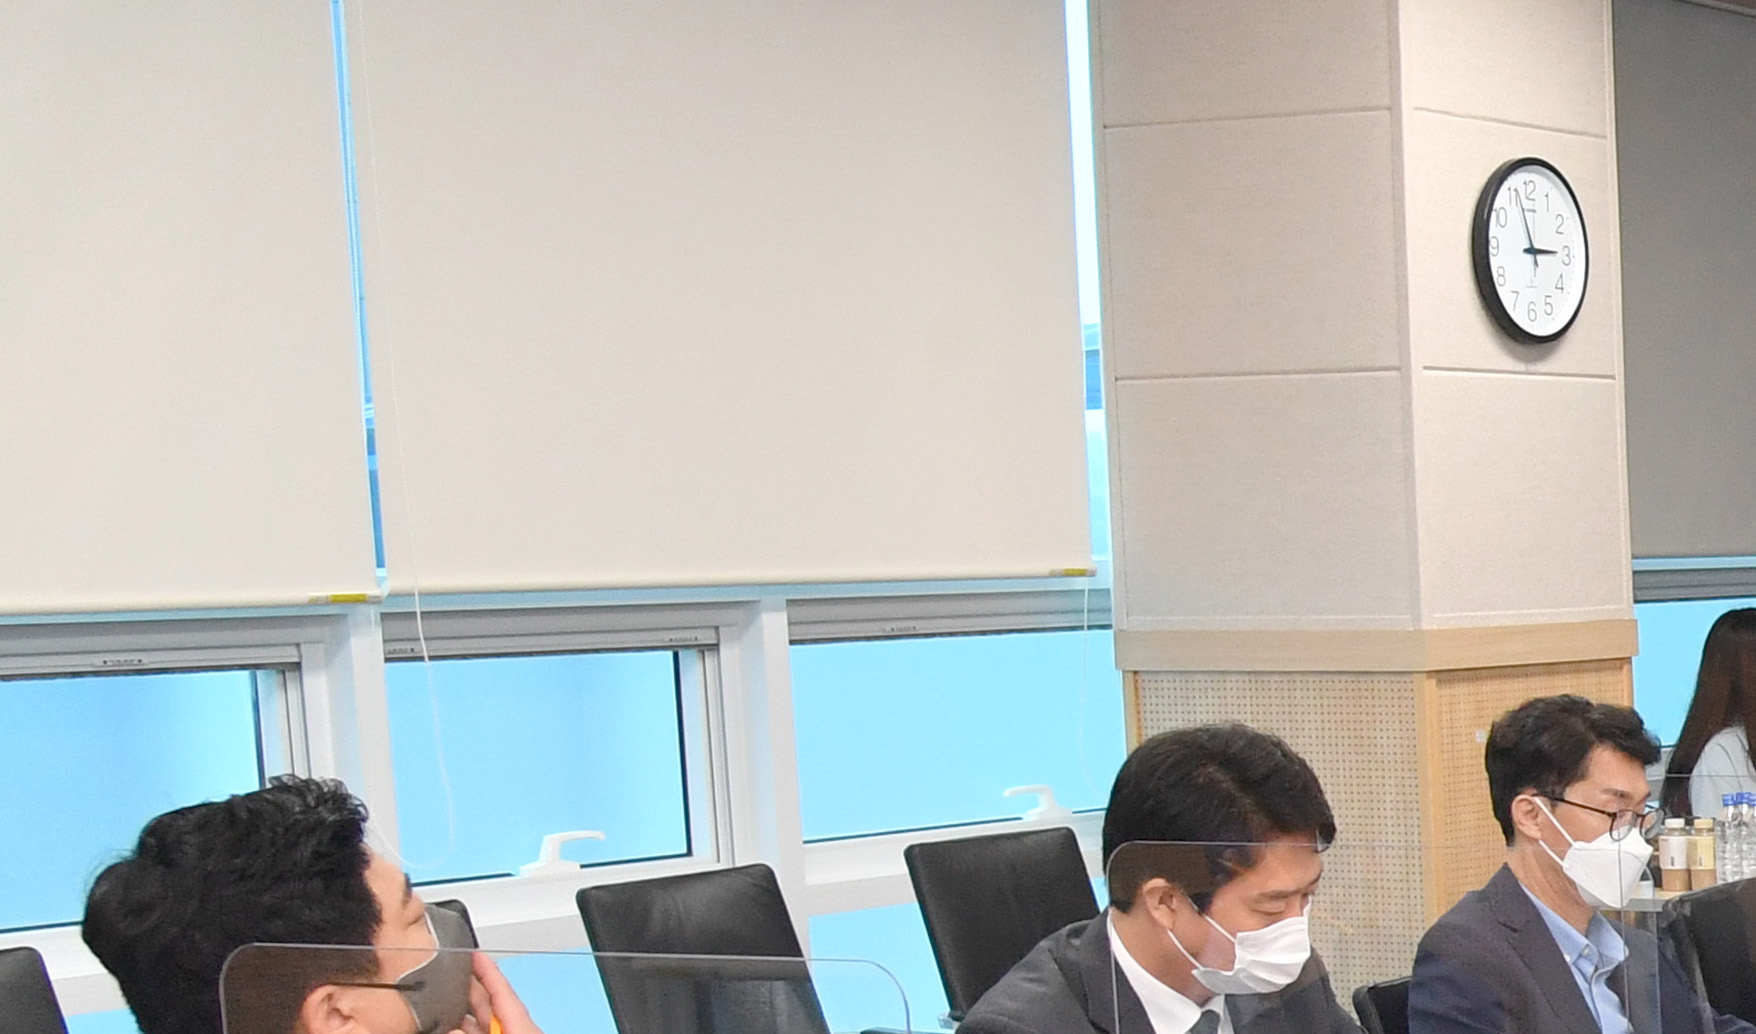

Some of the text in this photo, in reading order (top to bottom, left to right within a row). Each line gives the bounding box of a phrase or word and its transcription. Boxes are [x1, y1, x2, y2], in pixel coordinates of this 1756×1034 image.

[1523, 180, 1536, 201] 12
[1544, 192, 1549, 213] 1
[1493, 206, 1508, 229] 10
[1555, 213, 1565, 235] 2
[1489, 235, 1500, 257] 9
[1562, 245, 1572, 267] 3
[1496, 265, 1506, 287] 8
[1554, 273, 1564, 294] 4
[1510, 290, 1520, 311] 7
[1544, 295, 1554, 316] 5
[1527, 301, 1538, 322] 6
